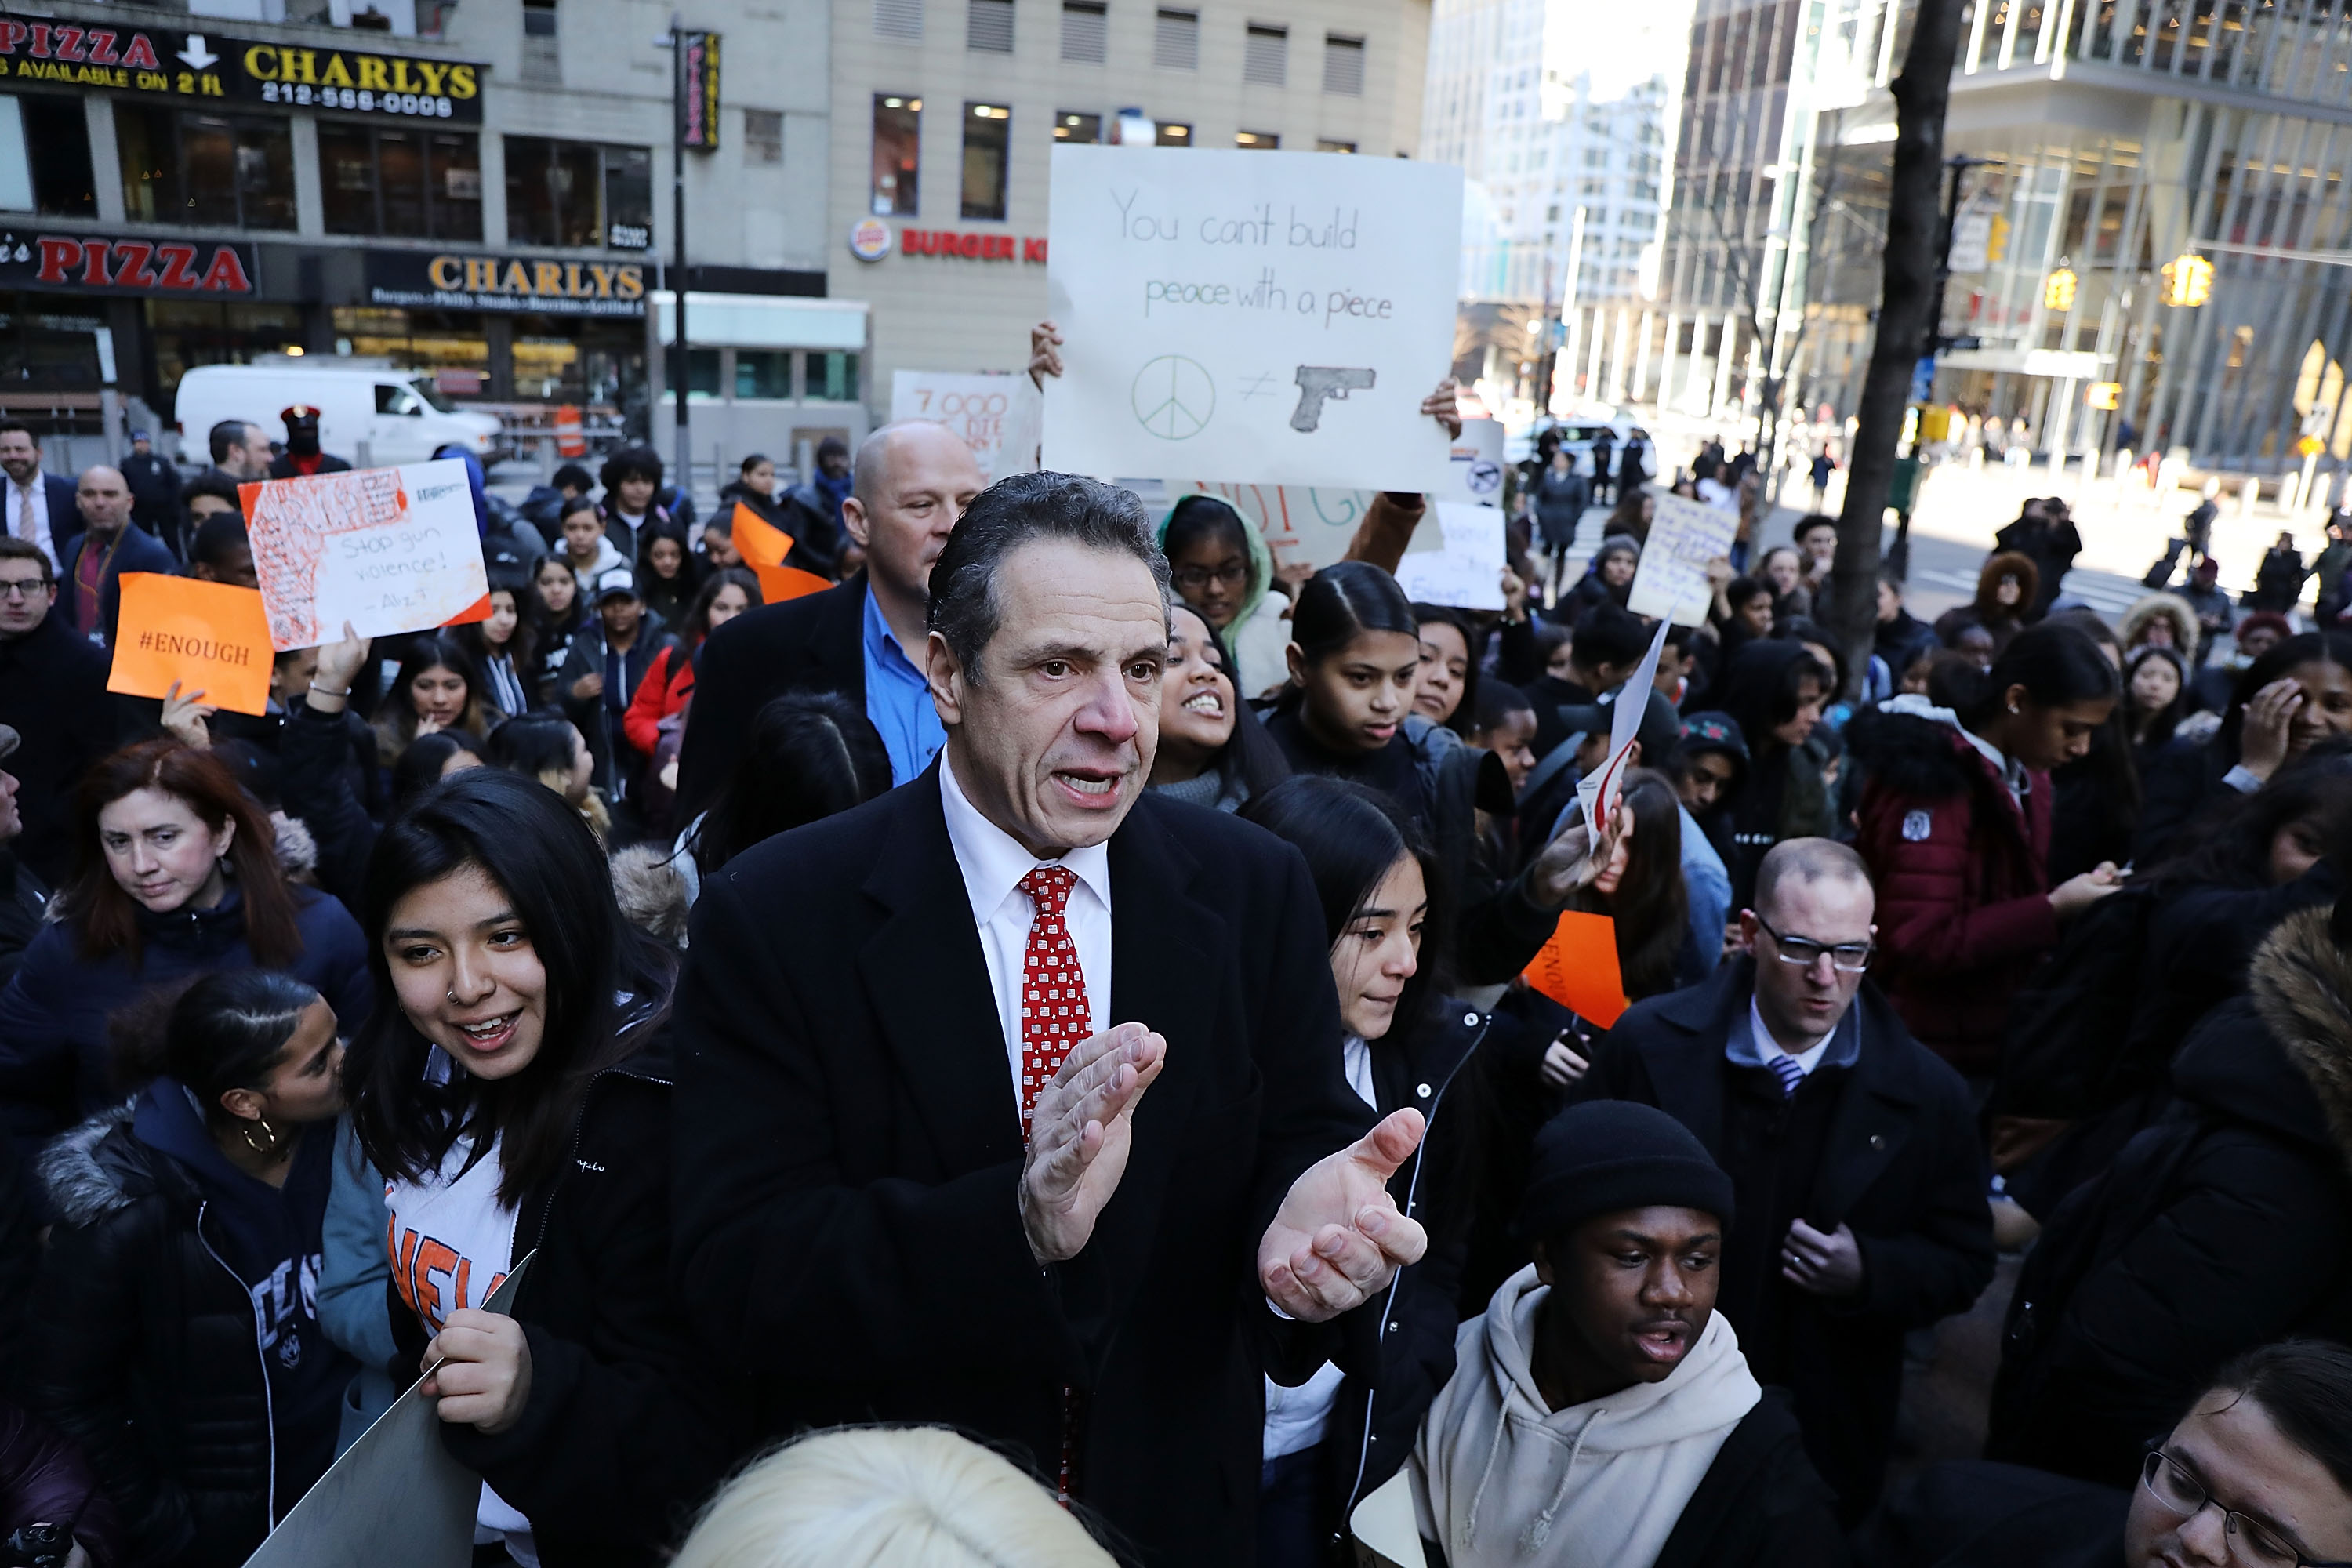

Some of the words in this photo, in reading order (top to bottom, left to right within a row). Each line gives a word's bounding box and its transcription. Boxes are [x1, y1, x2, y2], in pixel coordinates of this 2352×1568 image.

[0, 19, 160, 70] PIZZA
[17, 60, 129, 88] AVAILABLE
[136, 71, 169, 92] ON
[176, 71, 195, 94] 2
[244, 45, 477, 99] CHARLYS
[1110, 187, 1179, 241] You
[1200, 203, 1276, 245] can't
[1288, 205, 1358, 249] build
[36, 236, 252, 292] PIZZA
[901, 228, 1015, 260] BURGER
[428, 255, 644, 299] CHARLYS
[1145, 280, 1231, 318] peace
[1236, 267, 1287, 311] with
[1298, 291, 1316, 314] a
[1324, 288, 1392, 330] piece
[341, 535, 394, 559] Stop
[400, 527, 441, 553] gun
[140, 630, 249, 666] #ENOUGH
